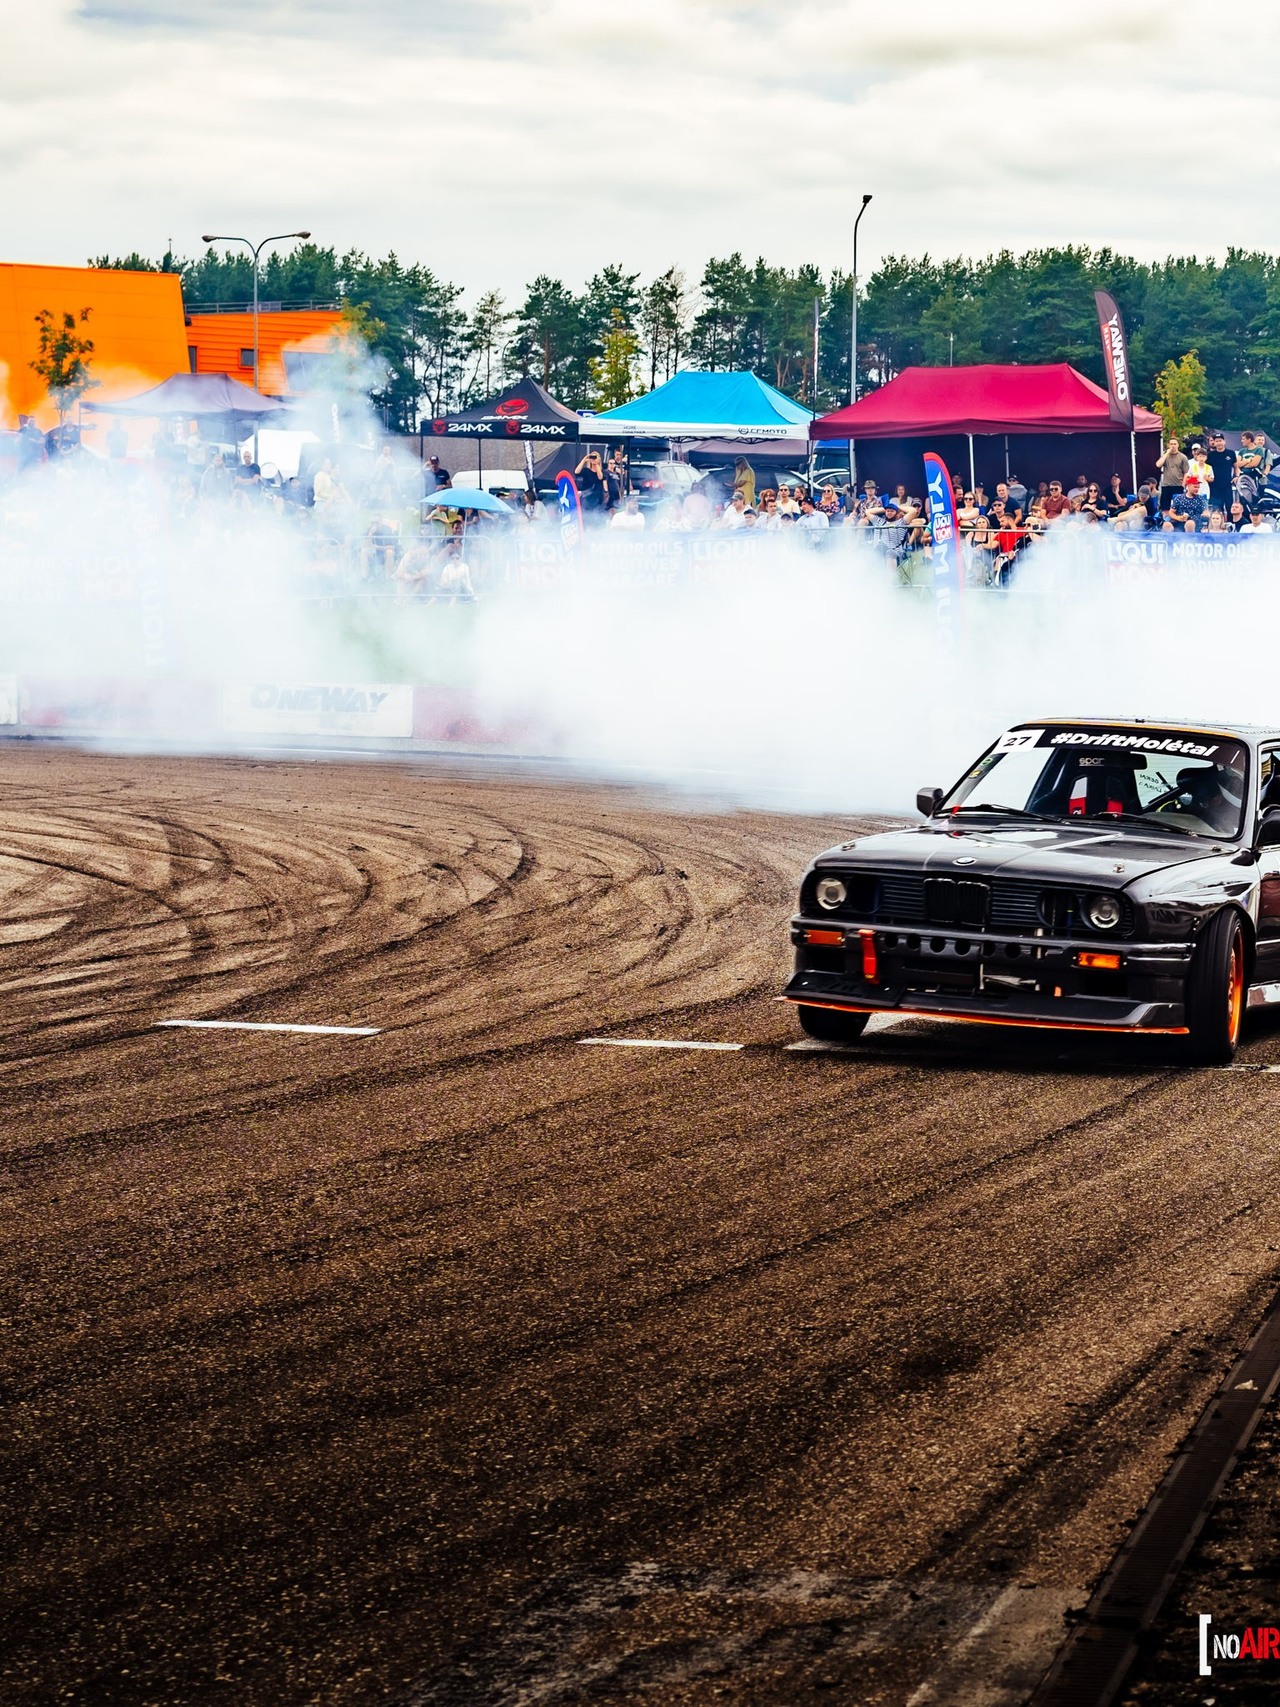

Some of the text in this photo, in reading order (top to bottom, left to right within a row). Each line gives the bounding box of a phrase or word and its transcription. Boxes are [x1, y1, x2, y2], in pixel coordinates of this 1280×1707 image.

[448, 424, 493, 433] 24MX
[520, 425, 566, 435] 24MX
[1106, 542, 1164, 564] LIQUI
[1173, 543, 1258, 559] MOTOR OILS
[250, 684, 390, 713] ONEWAY
[1003, 736, 1032, 747] 27
